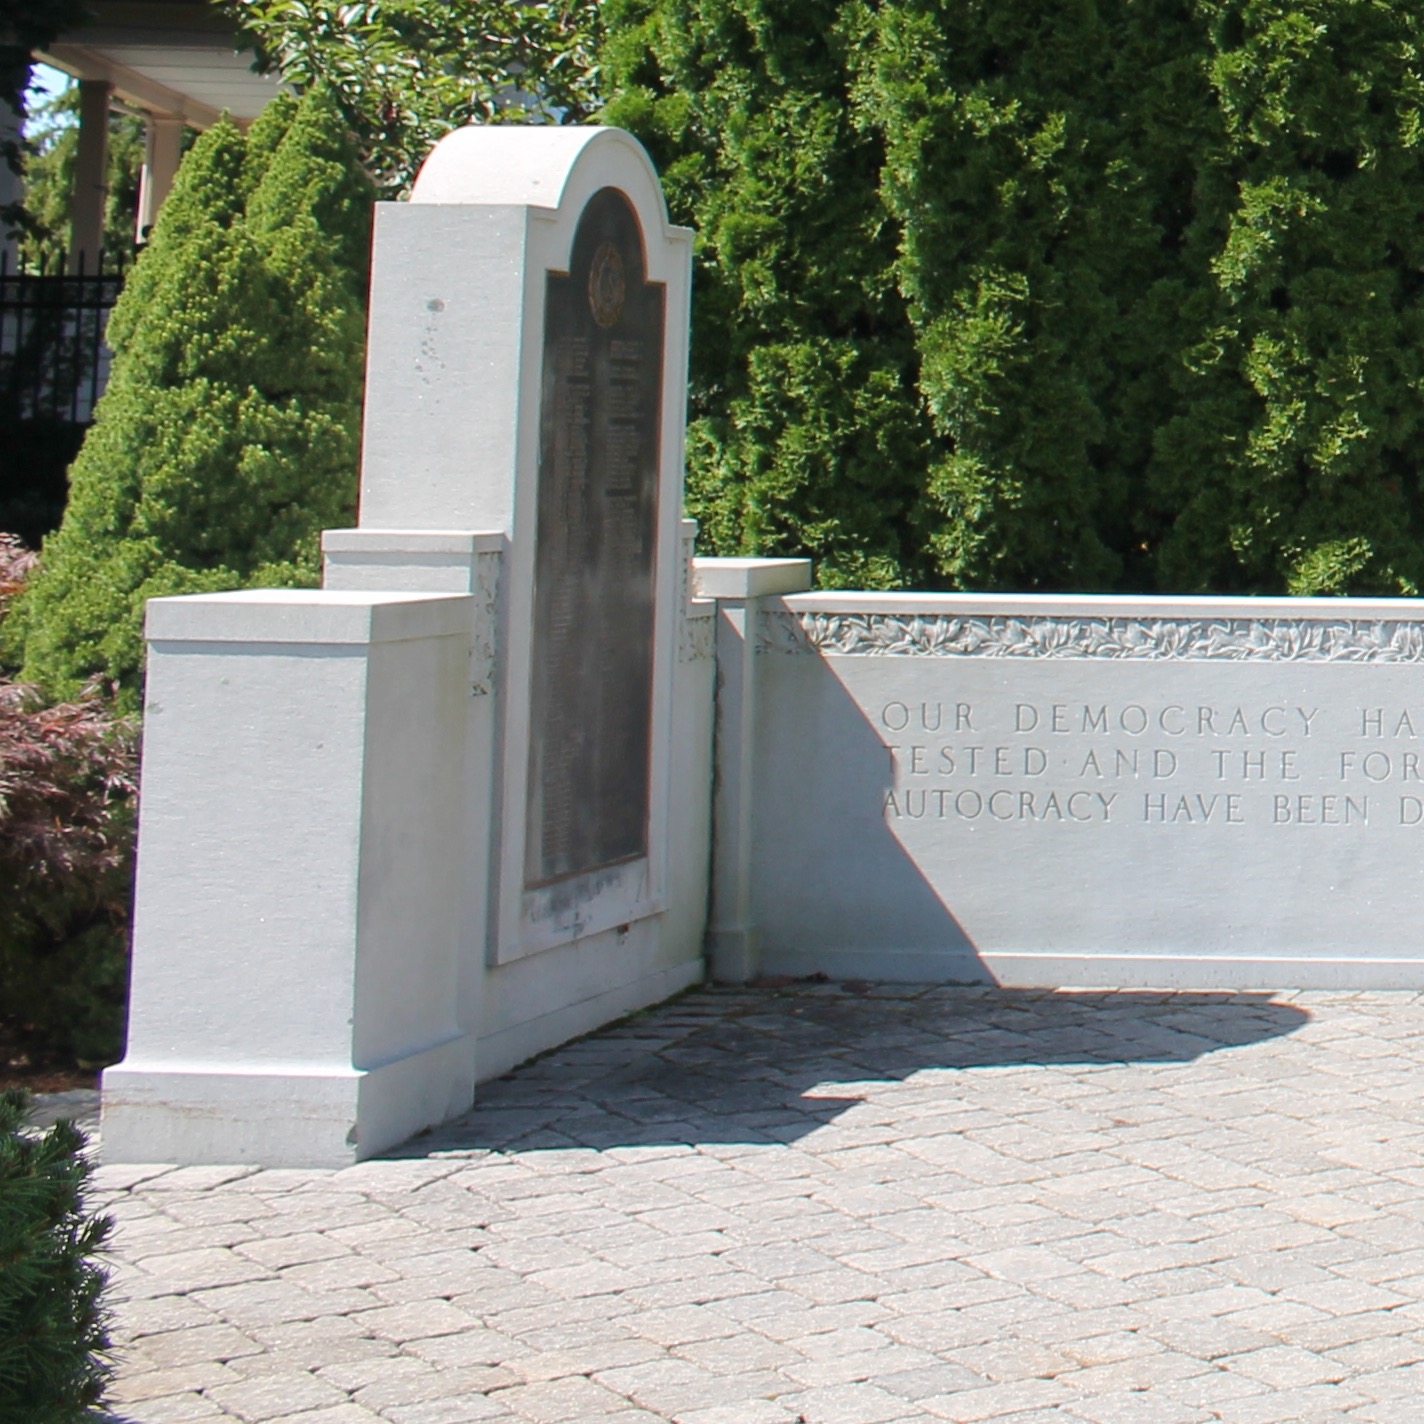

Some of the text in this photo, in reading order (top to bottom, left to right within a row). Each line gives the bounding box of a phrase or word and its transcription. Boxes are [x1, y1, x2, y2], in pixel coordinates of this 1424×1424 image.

[882, 701, 978, 732] OUR
[1015, 704, 1319, 737] DEMOCRACY
[882, 746, 1048, 777] TESTED
[1080, 748, 1178, 779] AND
[1212, 749, 1300, 782] THE
[882, 789, 1118, 822] AUTOCRACY
[1143, 792, 1244, 824] HAVE
[1273, 794, 1369, 826] BEEN
